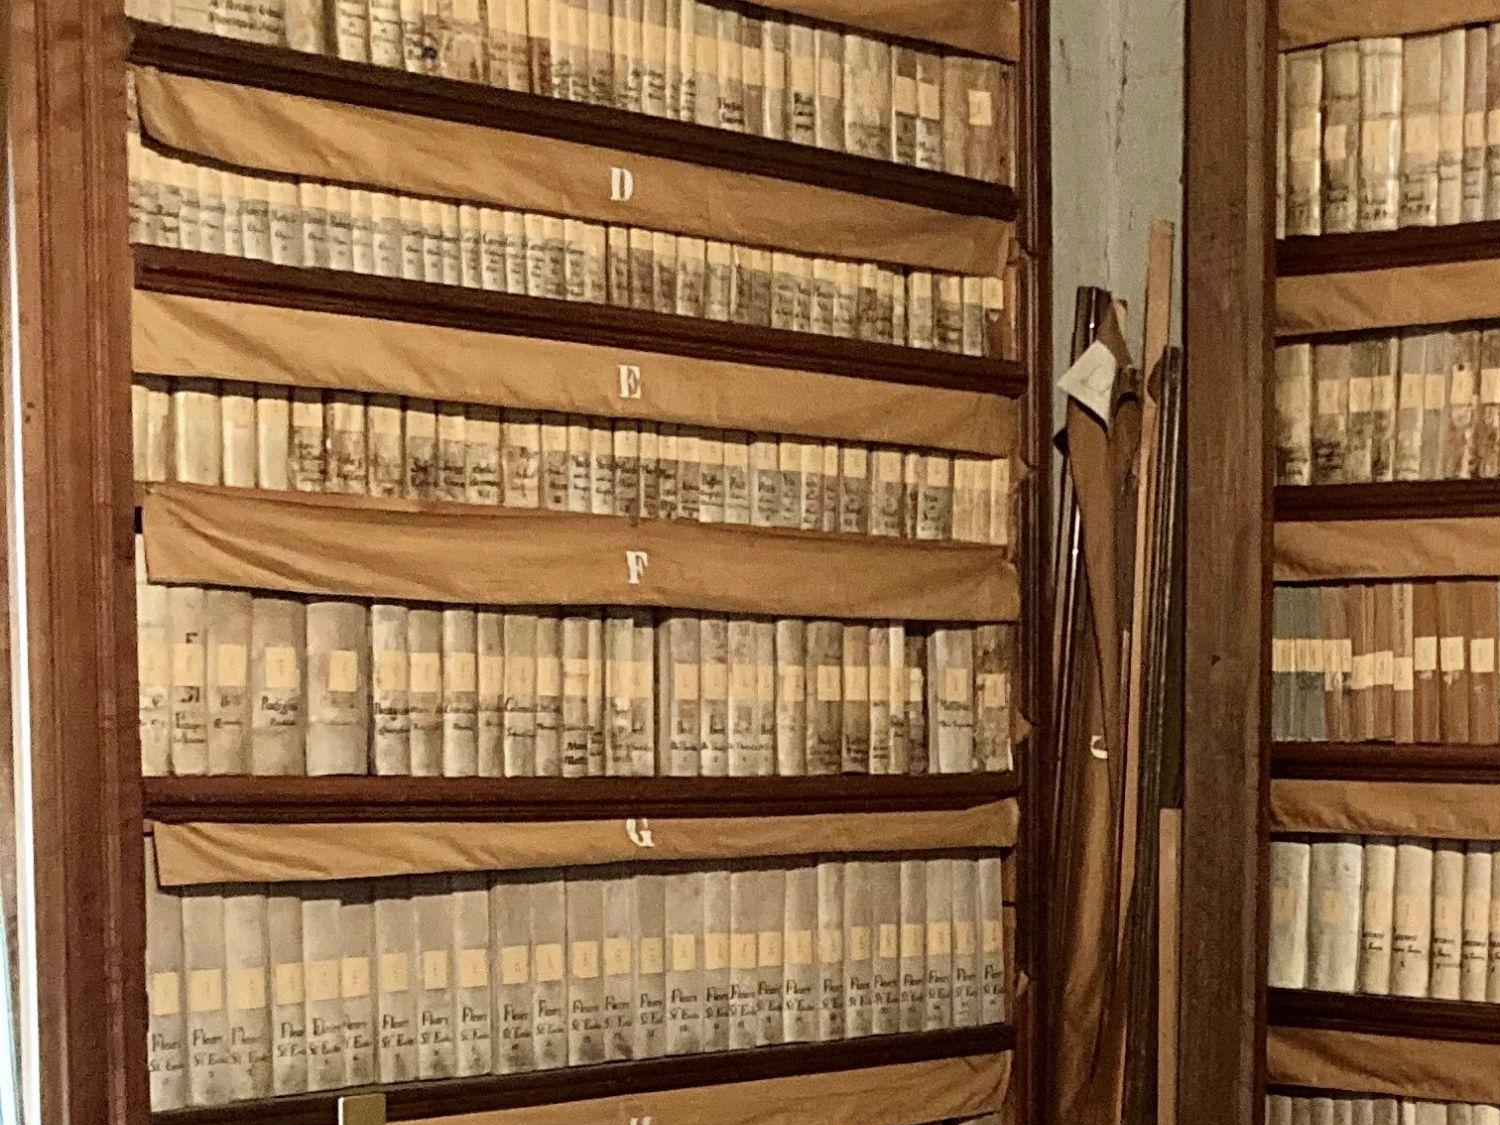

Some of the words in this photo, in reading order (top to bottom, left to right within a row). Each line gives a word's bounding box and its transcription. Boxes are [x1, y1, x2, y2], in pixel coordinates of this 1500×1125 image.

[610, 167, 633, 201] D
[618, 365, 640, 398] E
[625, 551, 648, 584] F
[625, 818, 654, 847] G
